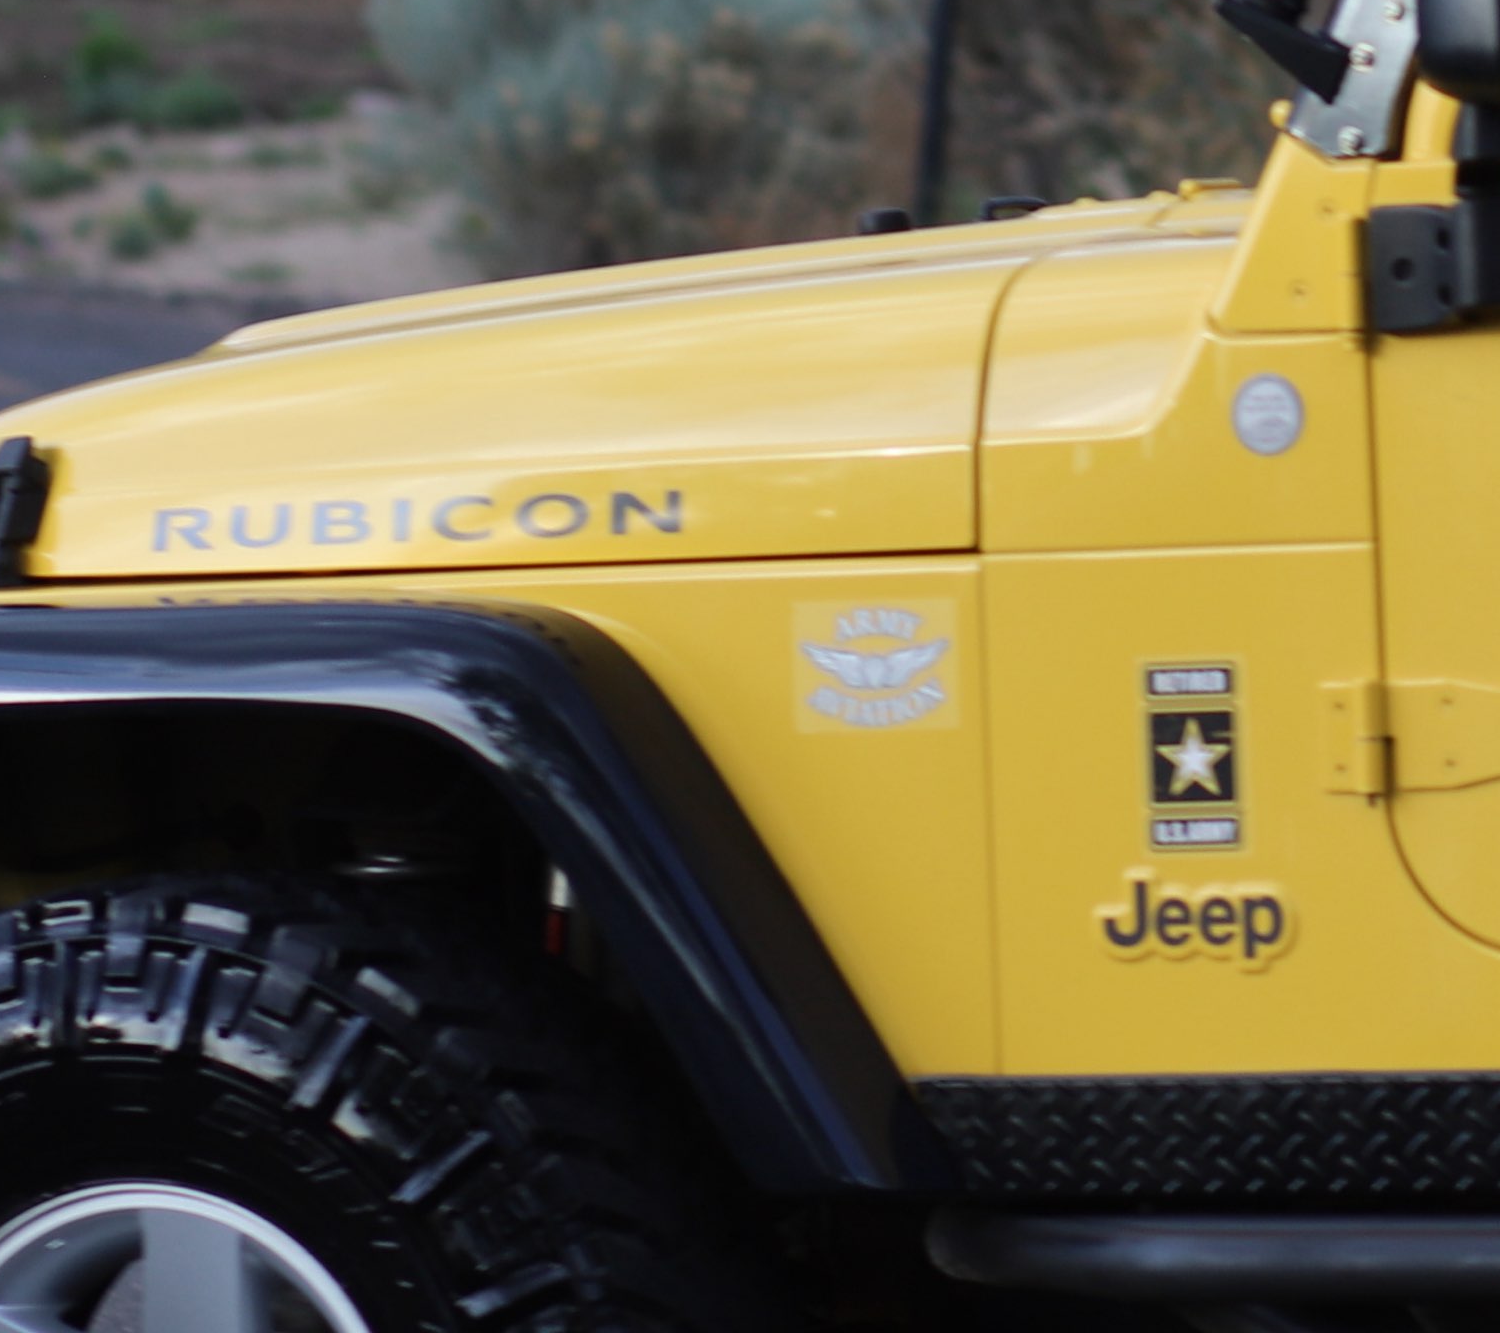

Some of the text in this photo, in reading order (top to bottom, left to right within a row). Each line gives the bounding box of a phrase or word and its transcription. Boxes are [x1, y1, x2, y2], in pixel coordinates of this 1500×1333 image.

[151, 489, 684, 552] RUBICON
[834, 607, 924, 642] ARMY
[1103, 879, 1284, 960] Jeep
